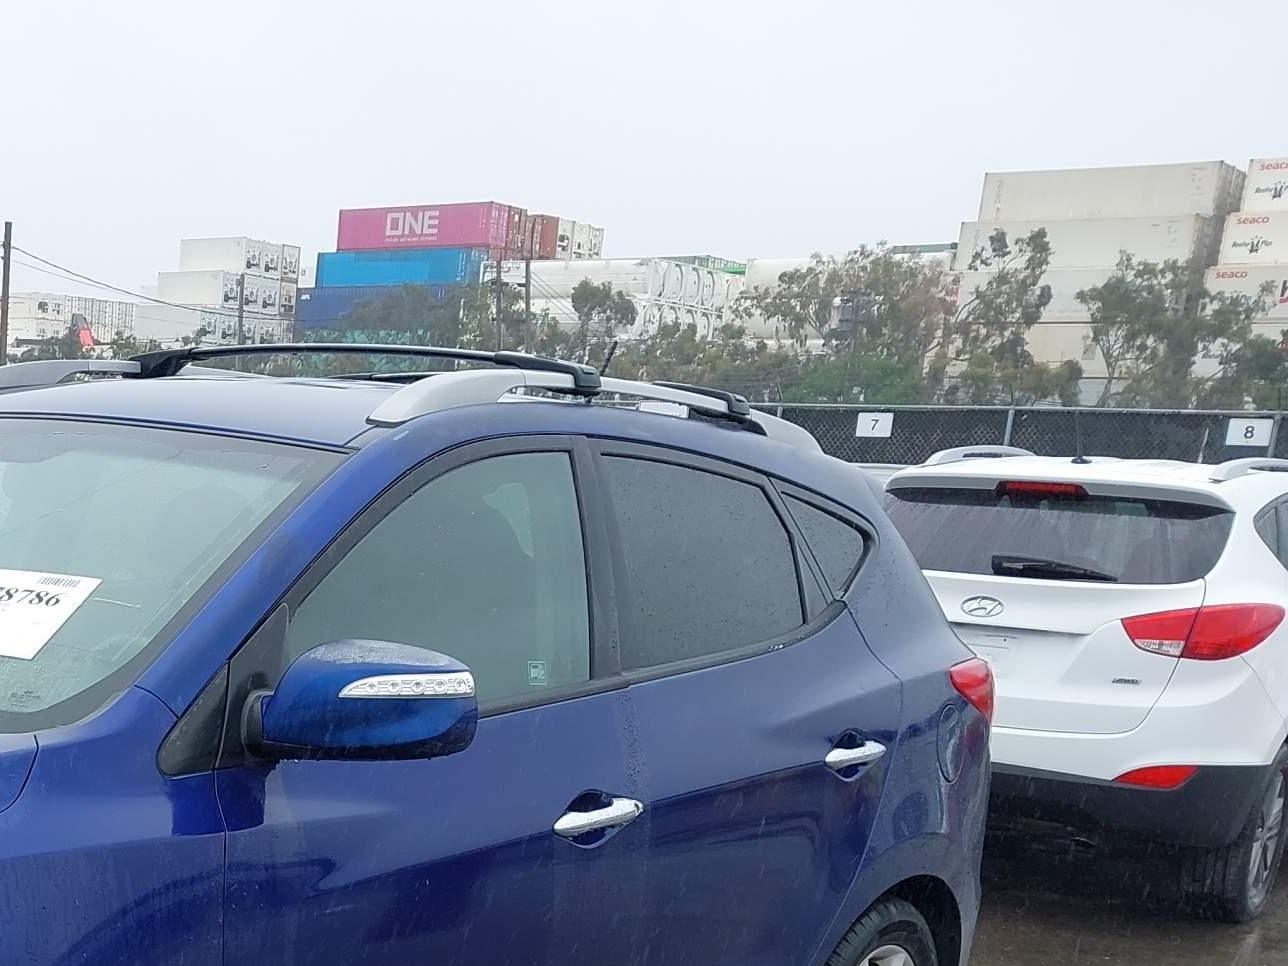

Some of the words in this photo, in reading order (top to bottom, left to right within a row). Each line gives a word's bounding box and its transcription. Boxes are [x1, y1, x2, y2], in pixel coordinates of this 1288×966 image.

[386, 210, 440, 236] ONE
[1236, 216, 1270, 225] seaco
[1215, 271, 1248, 279] seaco
[871, 418, 880, 431] 7
[1244, 425, 1255, 439] 8
